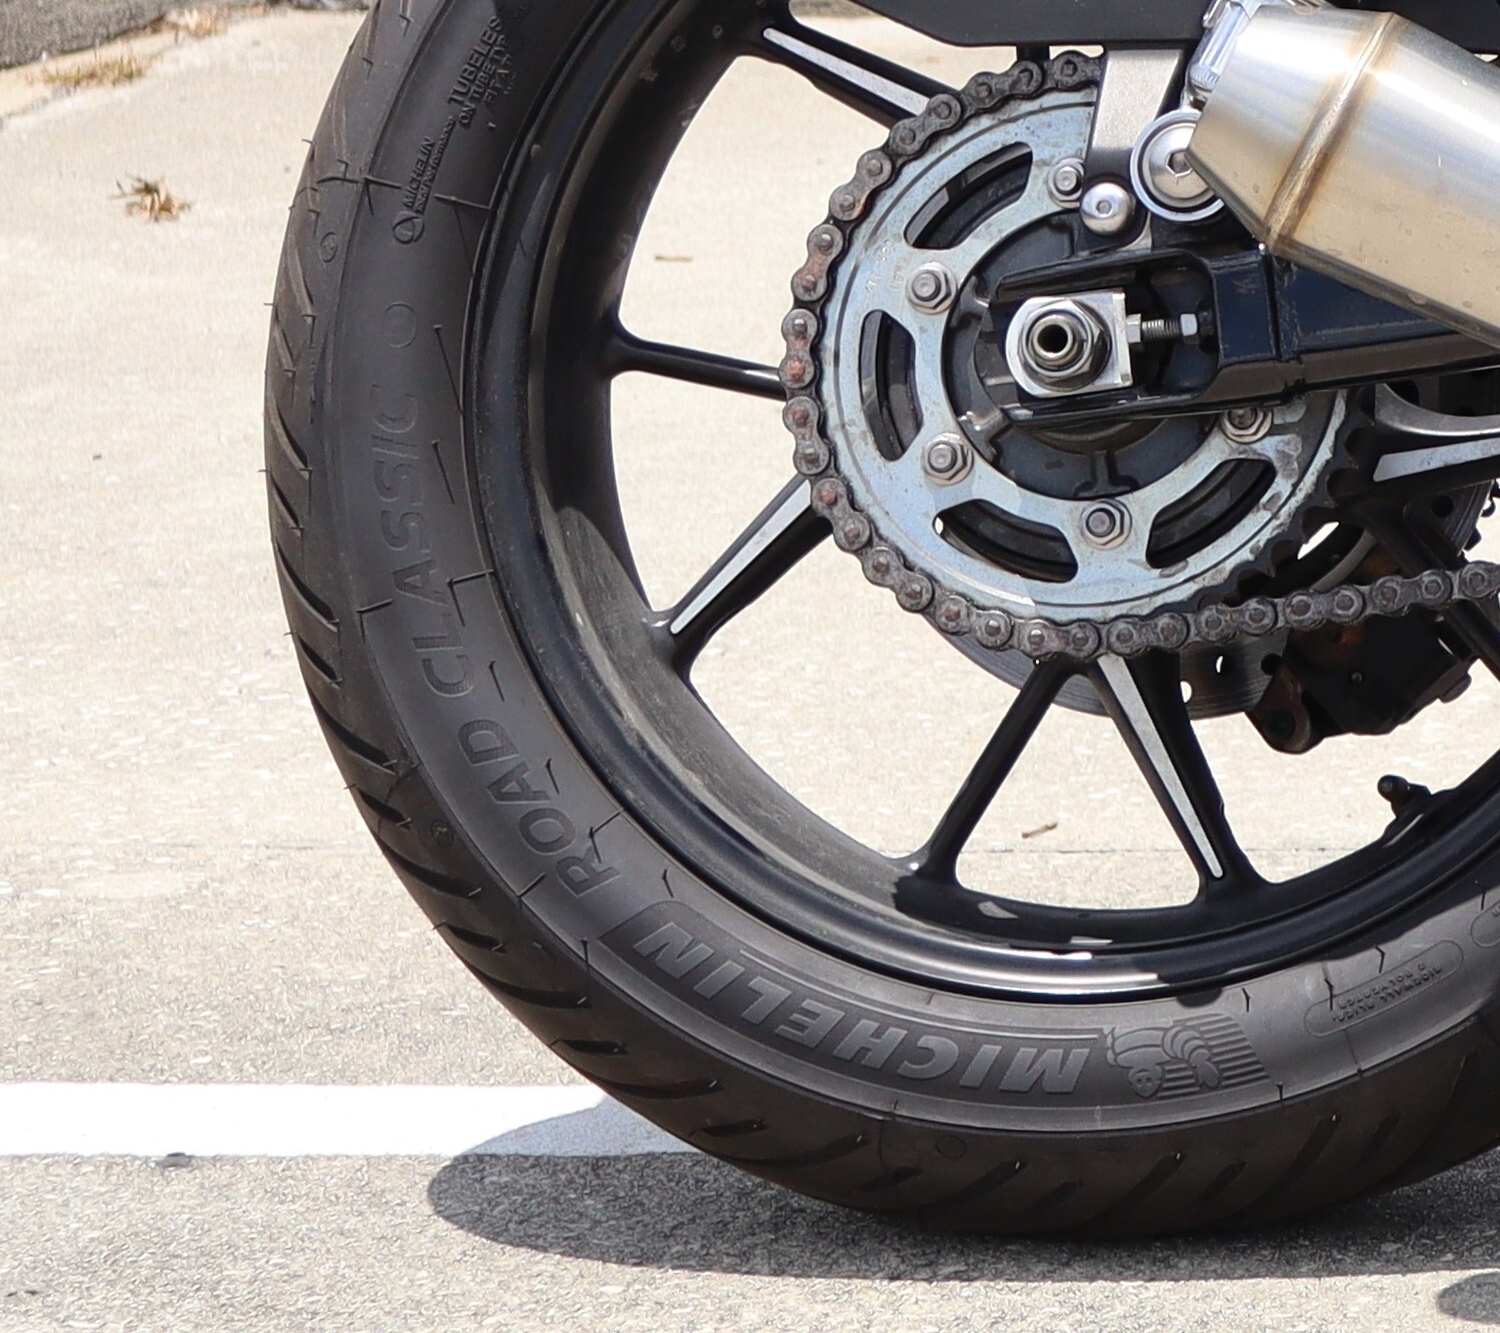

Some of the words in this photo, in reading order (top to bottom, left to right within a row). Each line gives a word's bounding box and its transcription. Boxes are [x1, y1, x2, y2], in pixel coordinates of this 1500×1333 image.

[369, 384, 480, 706] CLASSIC
[449, 708, 621, 909] ROAD
[630, 910, 1091, 1094] MICHELIN
